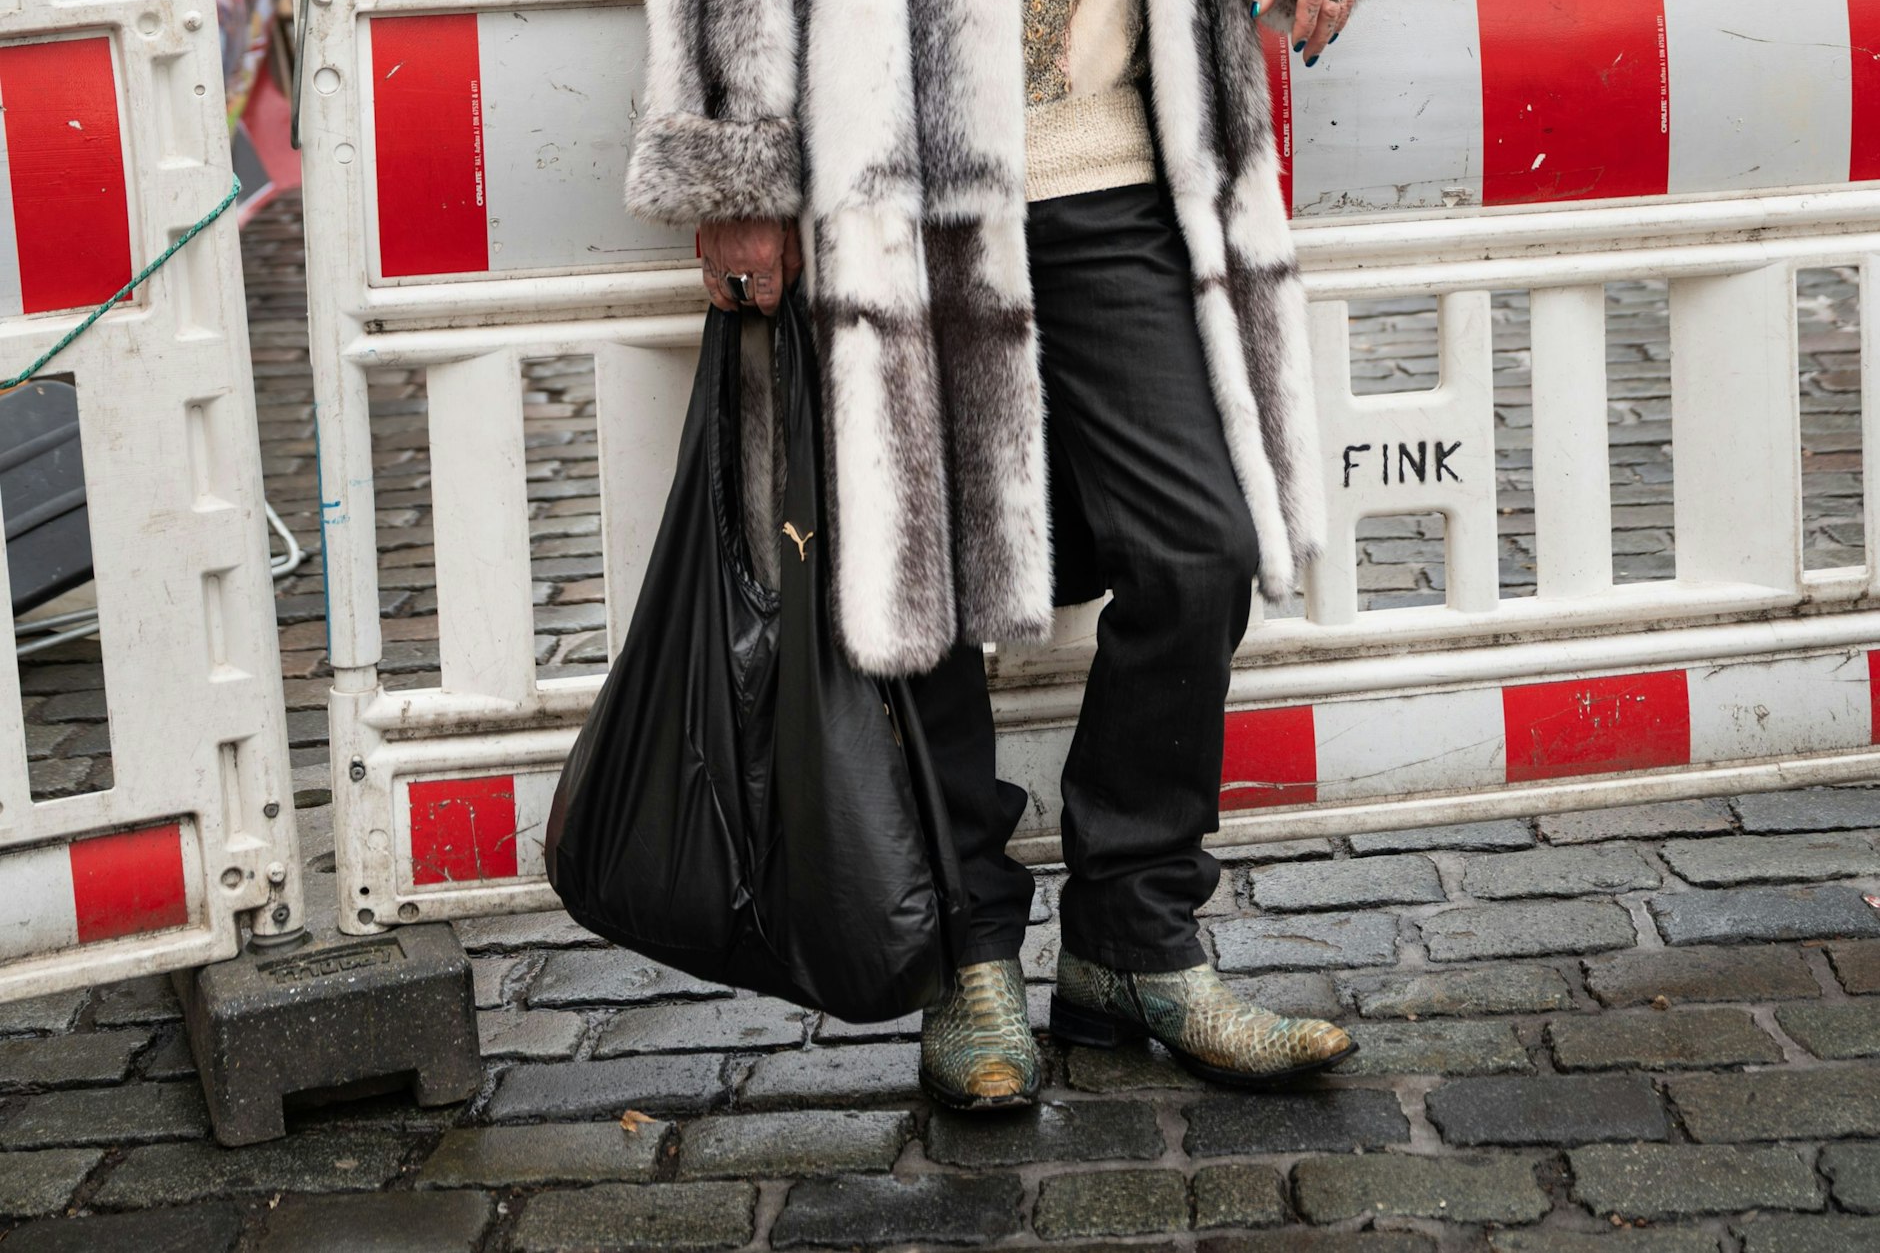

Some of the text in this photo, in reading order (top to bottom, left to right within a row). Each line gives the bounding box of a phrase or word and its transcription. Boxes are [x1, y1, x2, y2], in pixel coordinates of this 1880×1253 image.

[471, 99, 479, 116] 67520
[472, 116, 480, 126] DIN
[1342, 440, 1463, 488] FINK
